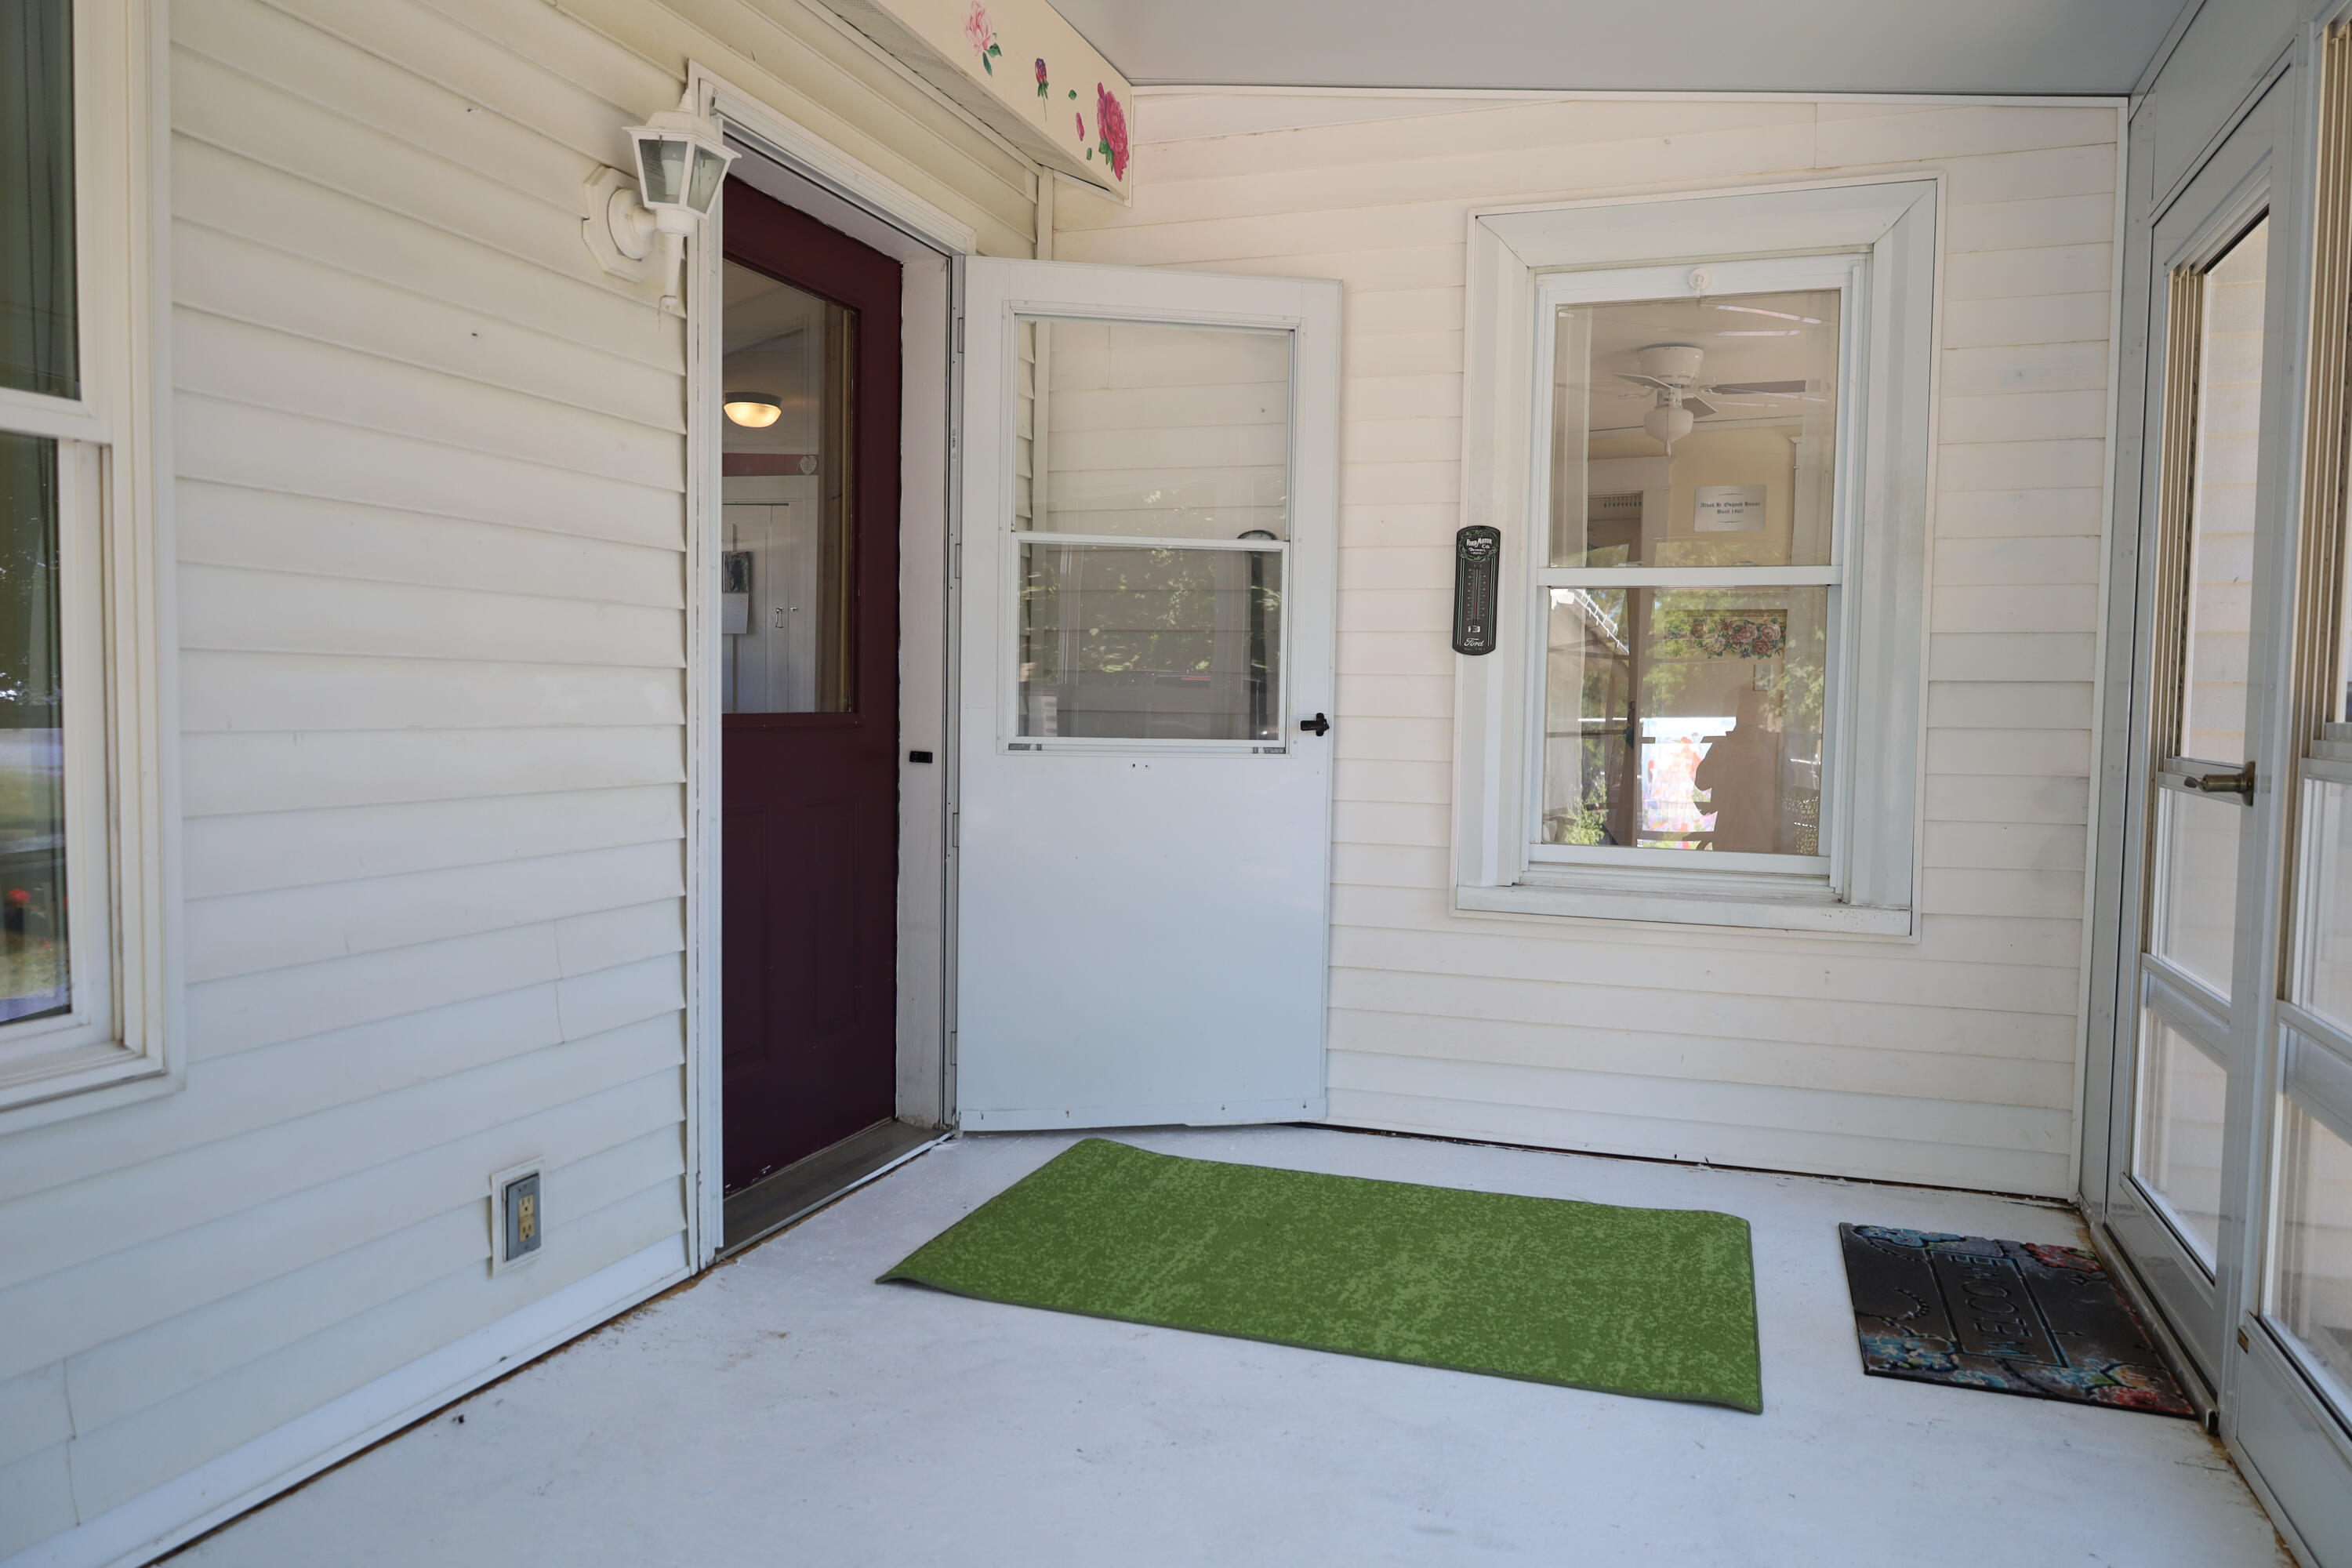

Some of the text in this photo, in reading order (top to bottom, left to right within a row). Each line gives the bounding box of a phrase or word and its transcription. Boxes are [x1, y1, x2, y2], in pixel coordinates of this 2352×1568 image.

[1475, 537, 1493, 548] MOTOR
[1464, 637, 1485, 647] Ford
[1947, 1253, 2038, 1358] WELCOME
